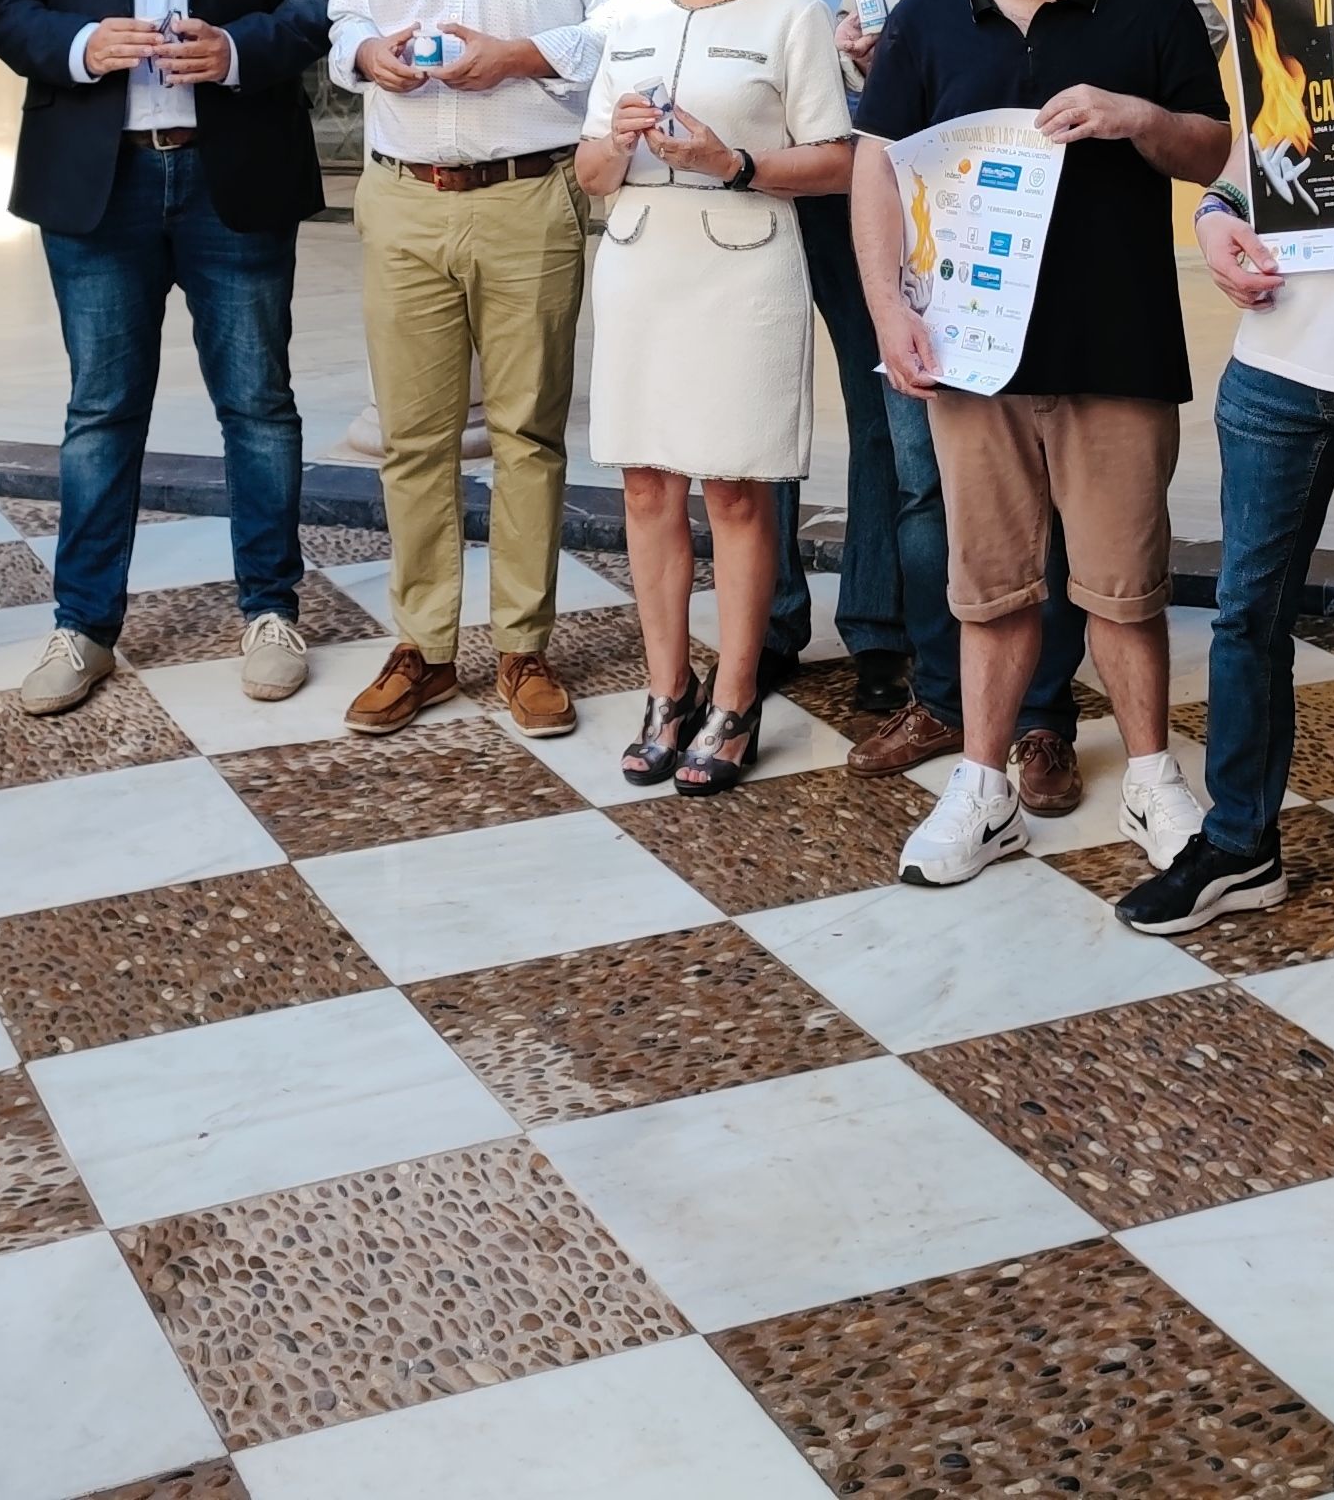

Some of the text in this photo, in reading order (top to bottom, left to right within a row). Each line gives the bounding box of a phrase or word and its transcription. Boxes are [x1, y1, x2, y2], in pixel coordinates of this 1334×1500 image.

[938, 131, 950, 143] VI
[951, 126, 982, 142] NOCHE
[985, 126, 996, 143] DE
[998, 127, 1015, 146] LAS
